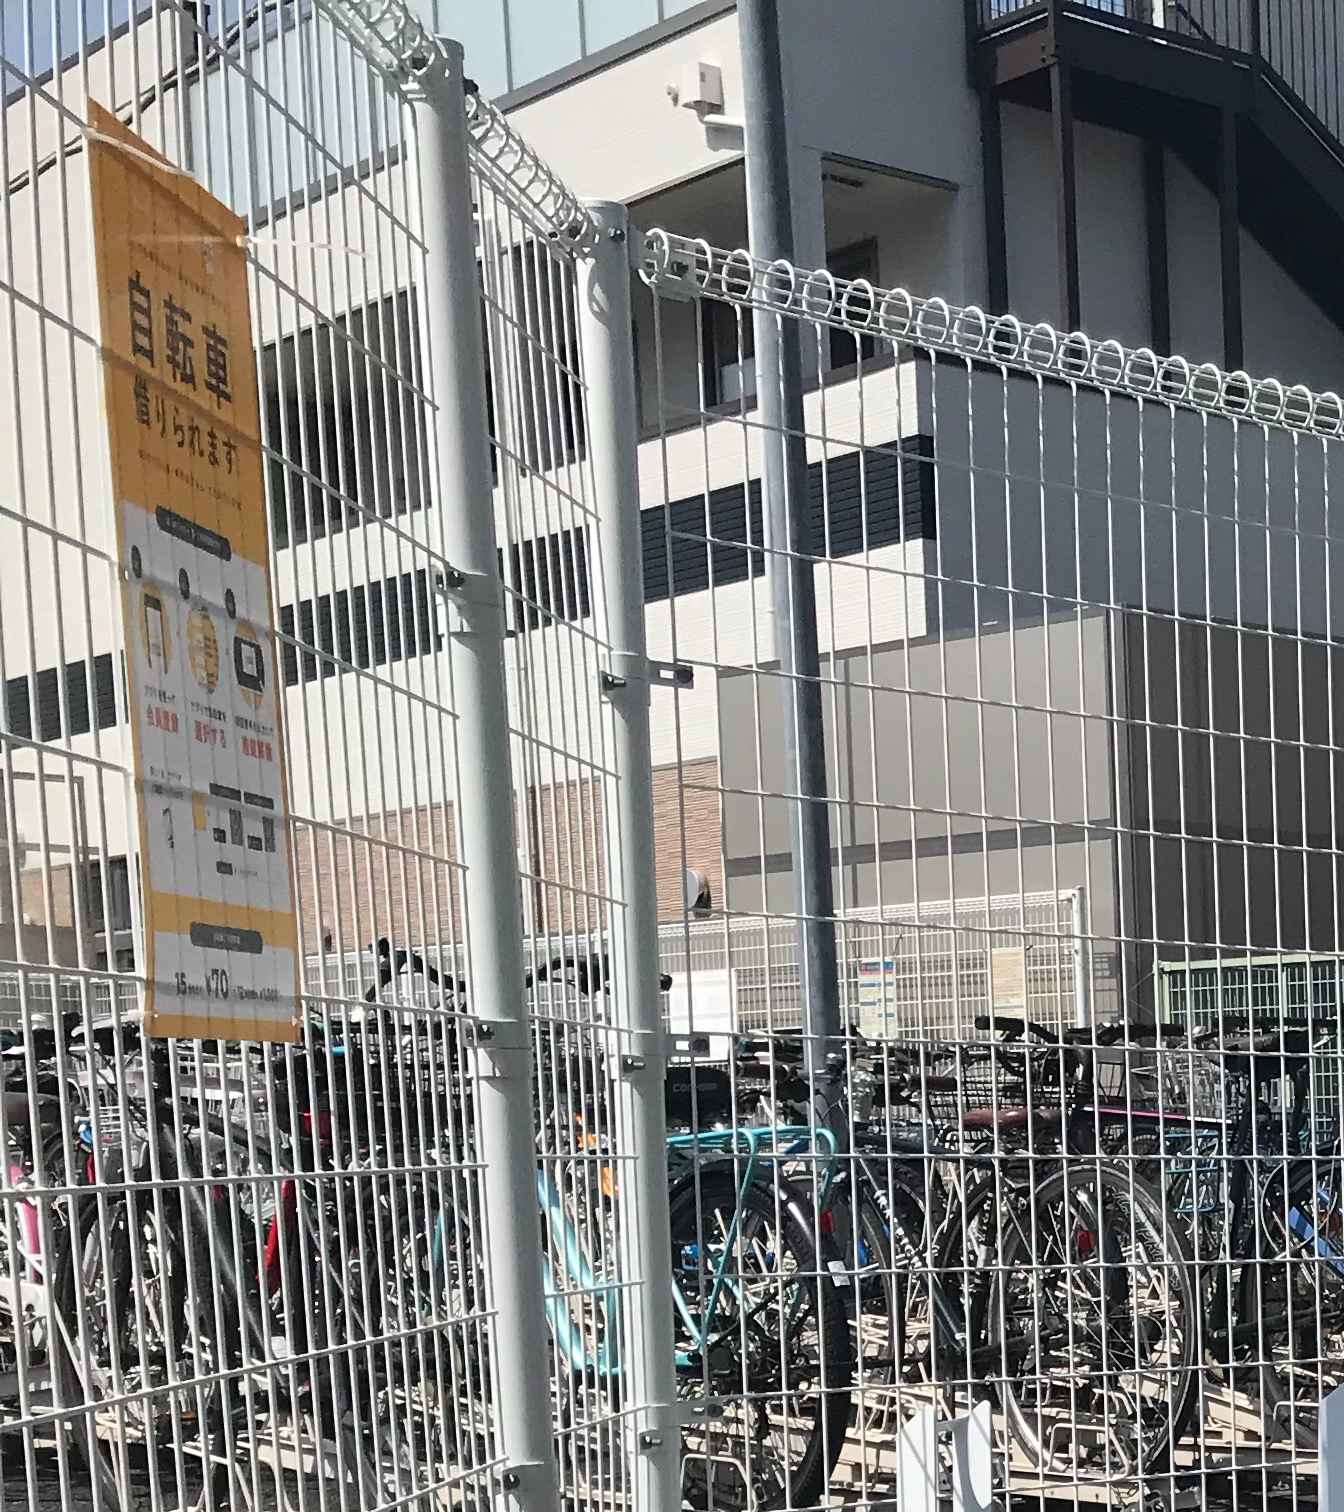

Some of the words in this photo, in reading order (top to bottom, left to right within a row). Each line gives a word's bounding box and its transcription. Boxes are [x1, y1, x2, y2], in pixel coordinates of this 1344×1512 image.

[127, 270, 233, 409] 自転車
[133, 374, 238, 474] 借りられます
